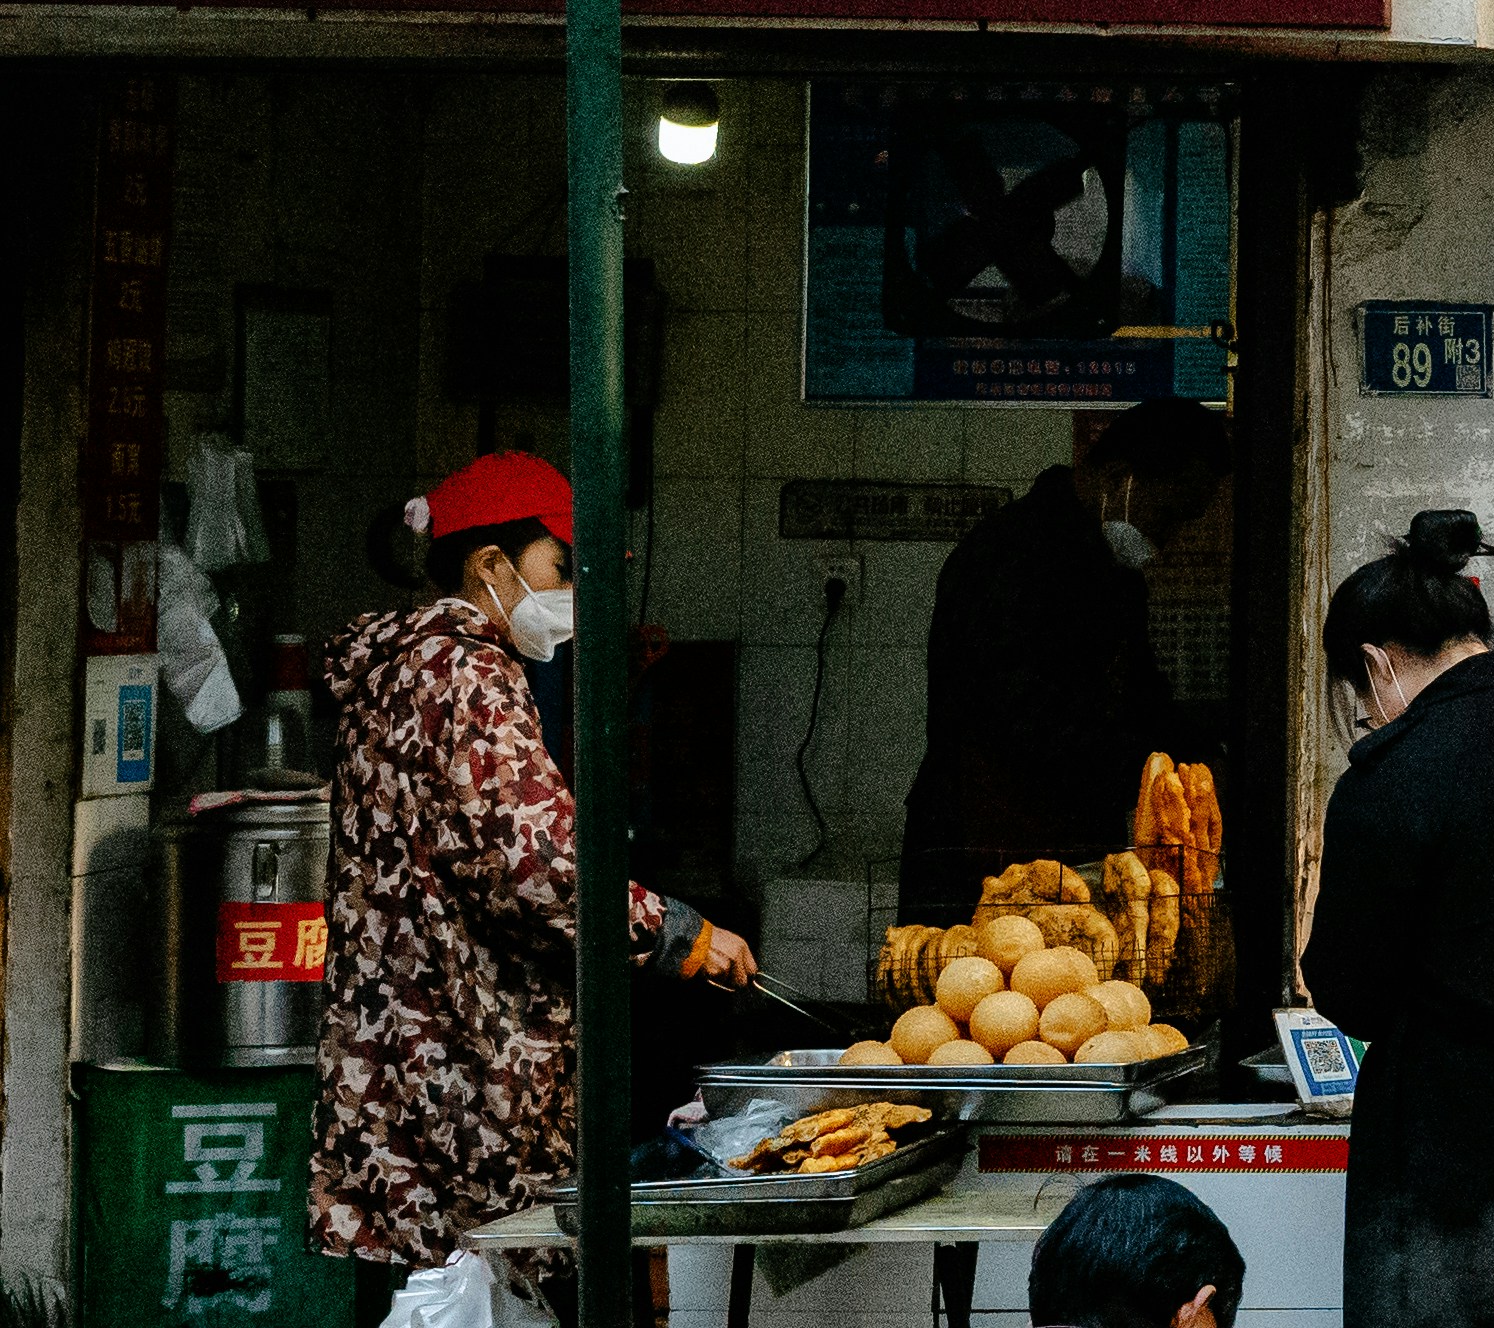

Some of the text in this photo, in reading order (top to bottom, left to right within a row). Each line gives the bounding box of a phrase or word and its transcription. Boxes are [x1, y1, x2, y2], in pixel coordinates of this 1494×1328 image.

[1391, 314, 1456, 337] 后补街
[1443, 336, 1482, 365] 附3
[1391, 341, 1433, 389] 89
[1054, 1144, 1284, 1164] 请在一米线以外等候
